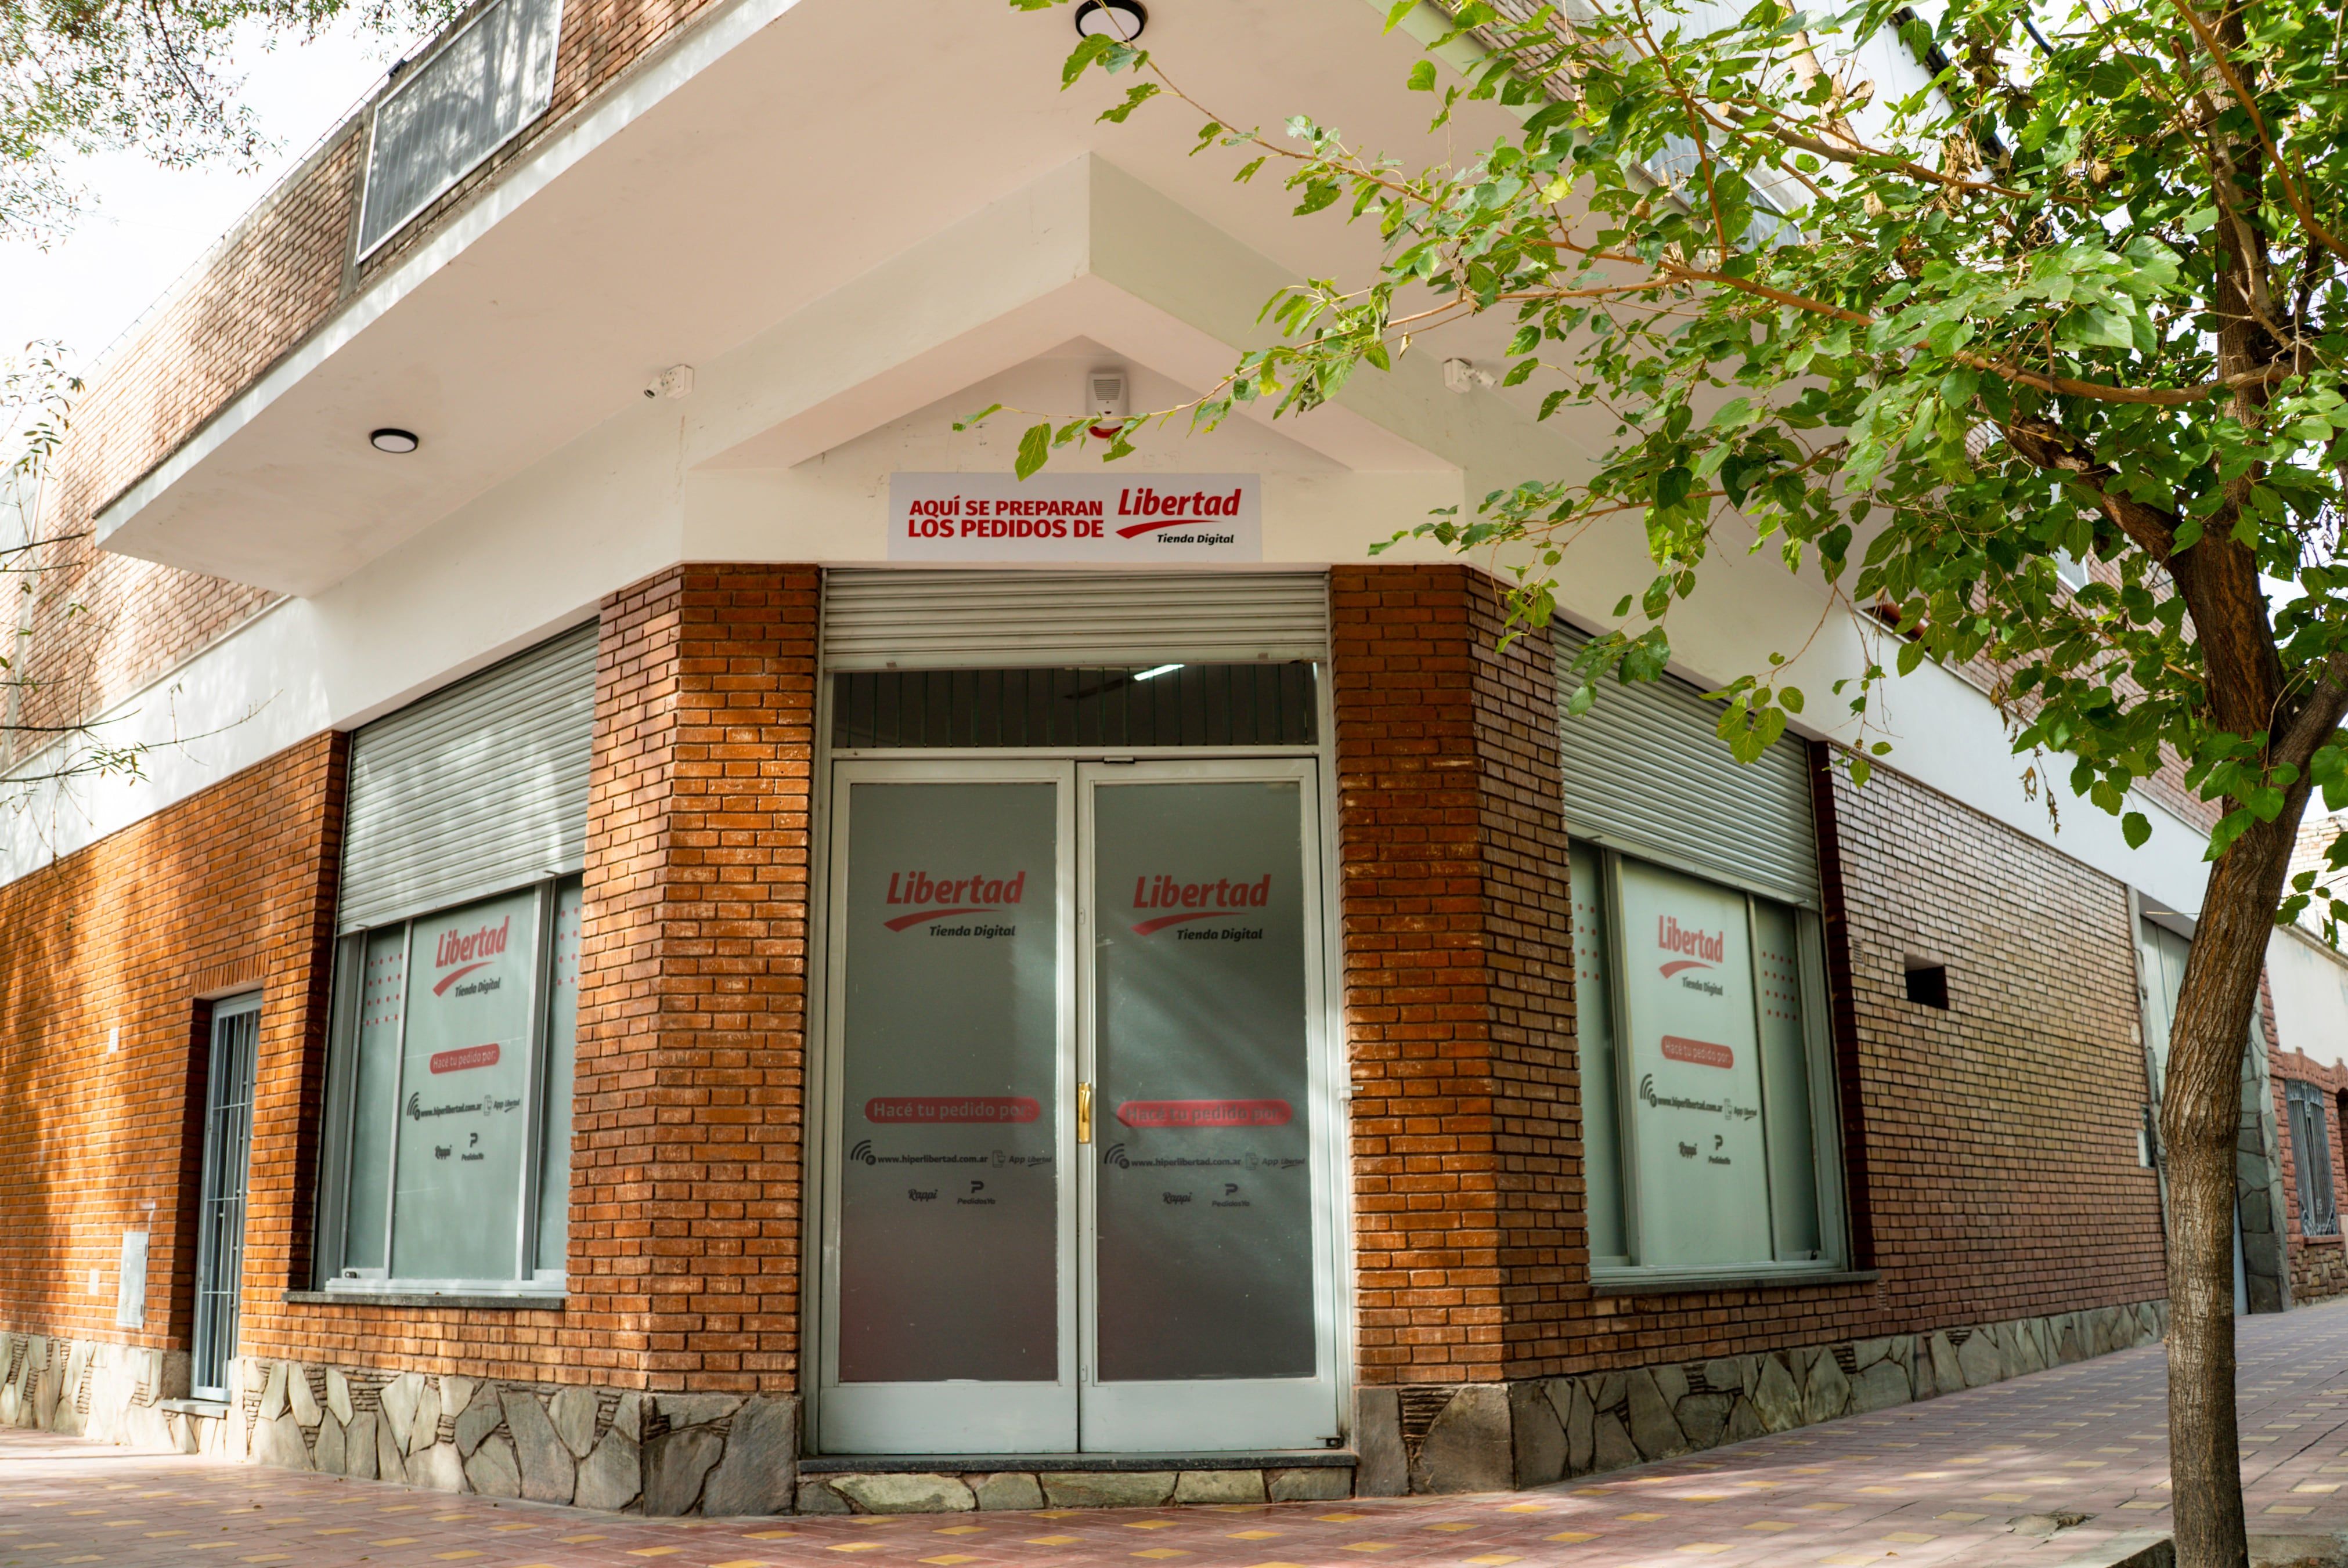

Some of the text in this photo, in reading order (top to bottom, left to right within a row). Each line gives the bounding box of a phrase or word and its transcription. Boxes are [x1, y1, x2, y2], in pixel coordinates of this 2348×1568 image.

[909, 495, 1103, 518] AQUÍ SE PREPARAN
[1117, 487, 1242, 516] Libertad
[908, 519, 1104, 538] LOS PEDIDOS DE
[1157, 534, 1234, 545] Tienda Digital
[886, 871, 1026, 905] Libertad
[1133, 874, 1271, 908] Libertad
[929, 926, 1015, 938] Tienda Digital
[1177, 928, 1263, 942] Tienda Digital
[1658, 915, 1723, 963] Libertad
[435, 916, 510, 968] Libertad
[455, 977, 501, 998] Tienda Digital
[1682, 976, 1723, 996] Tienda Digital
[432, 1057, 449, 1068] Hacé
[450, 1056, 458, 1067] tu
[458, 1050, 481, 1068] pedido
[874, 1102, 1032, 1119] Hacé tu pedido por:
[1126, 1105, 1165, 1122] Hacé
[1170, 1107, 1187, 1120] tu
[1192, 1104, 1247, 1122] pedido
[878, 1154, 988, 1165] www.hiperlibertad.com.ar
[1009, 1155, 1025, 1164] App
[1131, 1157, 1241, 1168] www.hiperlibertad.com.ar
[1262, 1158, 1278, 1167] App
[908, 1188, 938, 1202] Rappi
[1163, 1191, 1192, 1205] Rappi
